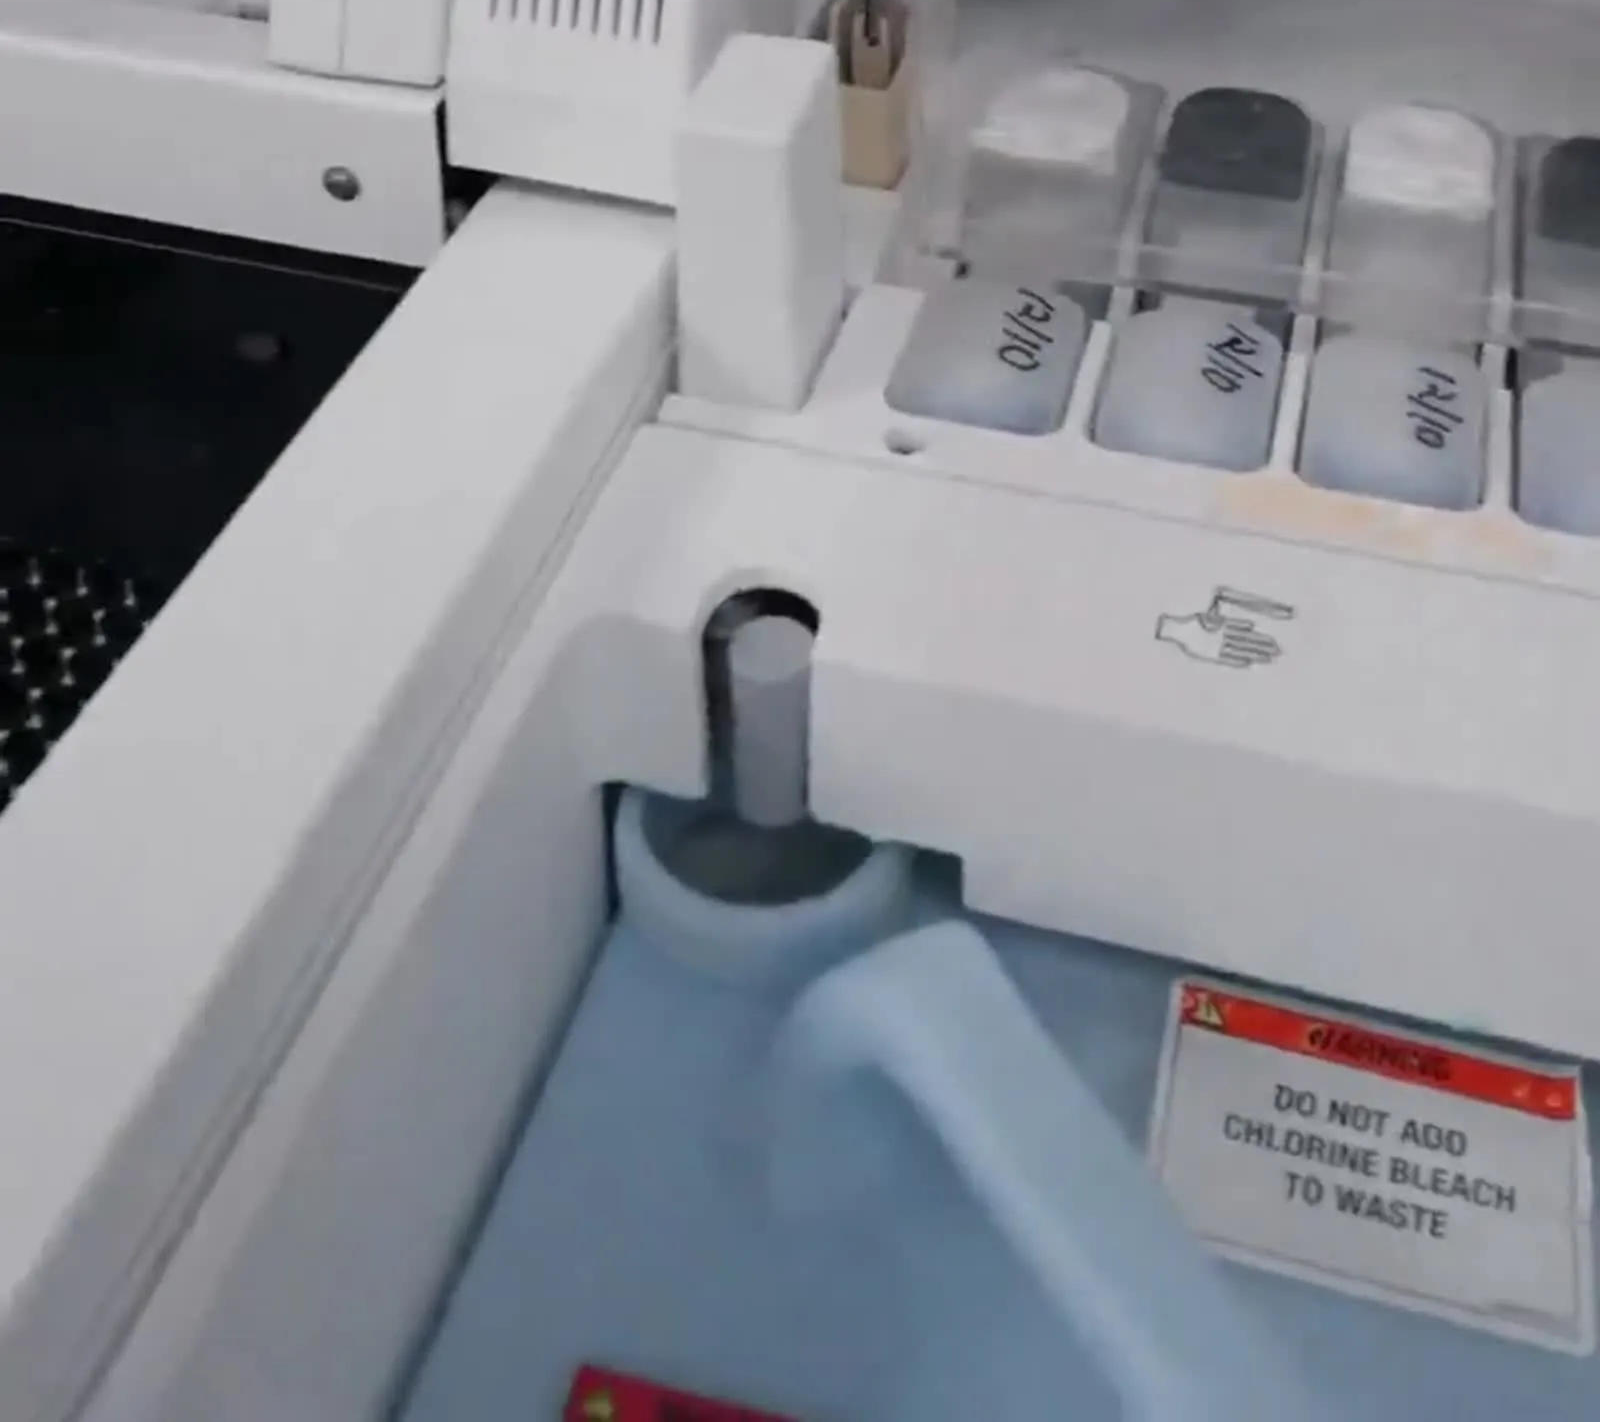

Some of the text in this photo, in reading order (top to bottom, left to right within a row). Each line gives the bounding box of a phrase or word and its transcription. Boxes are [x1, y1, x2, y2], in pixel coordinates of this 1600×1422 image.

[997, 286, 1058, 372] 12/10
[1200, 322, 1264, 396] 12/10
[1406, 366, 1466, 451] 12/10
[1274, 1083, 1467, 1158] DO NOT ADD
[1222, 1113, 1517, 1213] CHLORINE BLEACH
[1283, 1170, 1449, 1240] TO WASTE
